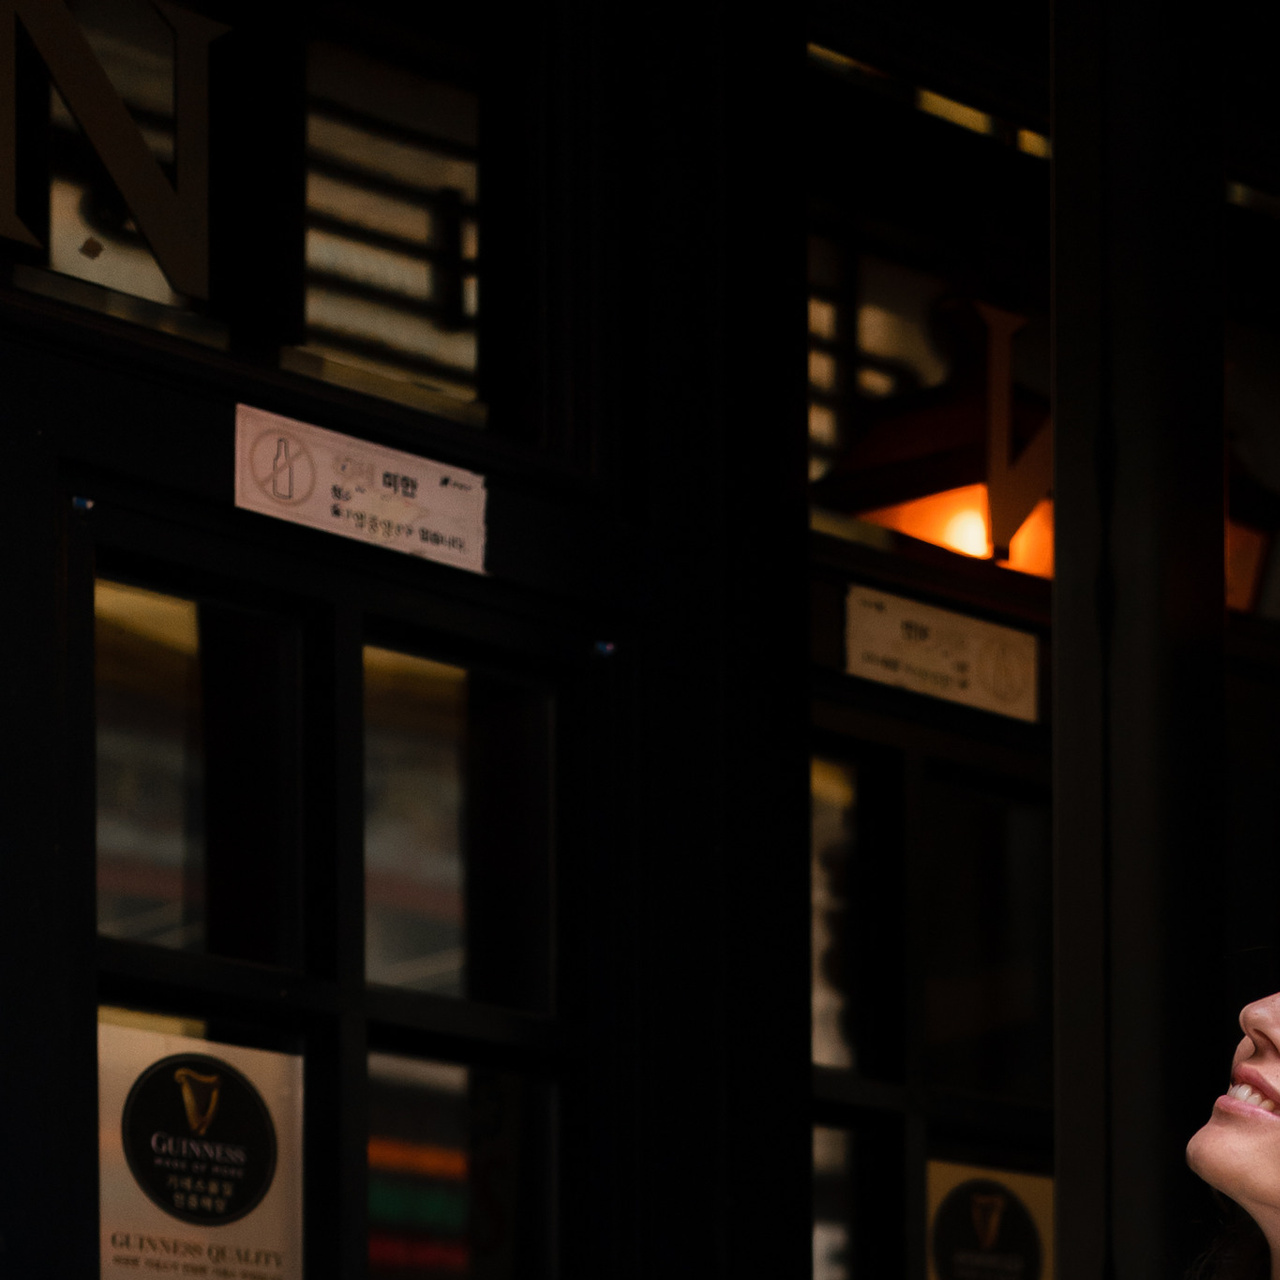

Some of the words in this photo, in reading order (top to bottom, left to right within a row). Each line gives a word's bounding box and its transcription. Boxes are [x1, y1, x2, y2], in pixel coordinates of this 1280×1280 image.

[150, 1130, 247, 1164] GUINNESS
[110, 1231, 204, 1257] GUINNESS
[206, 1242, 283, 1268] QUALITY
